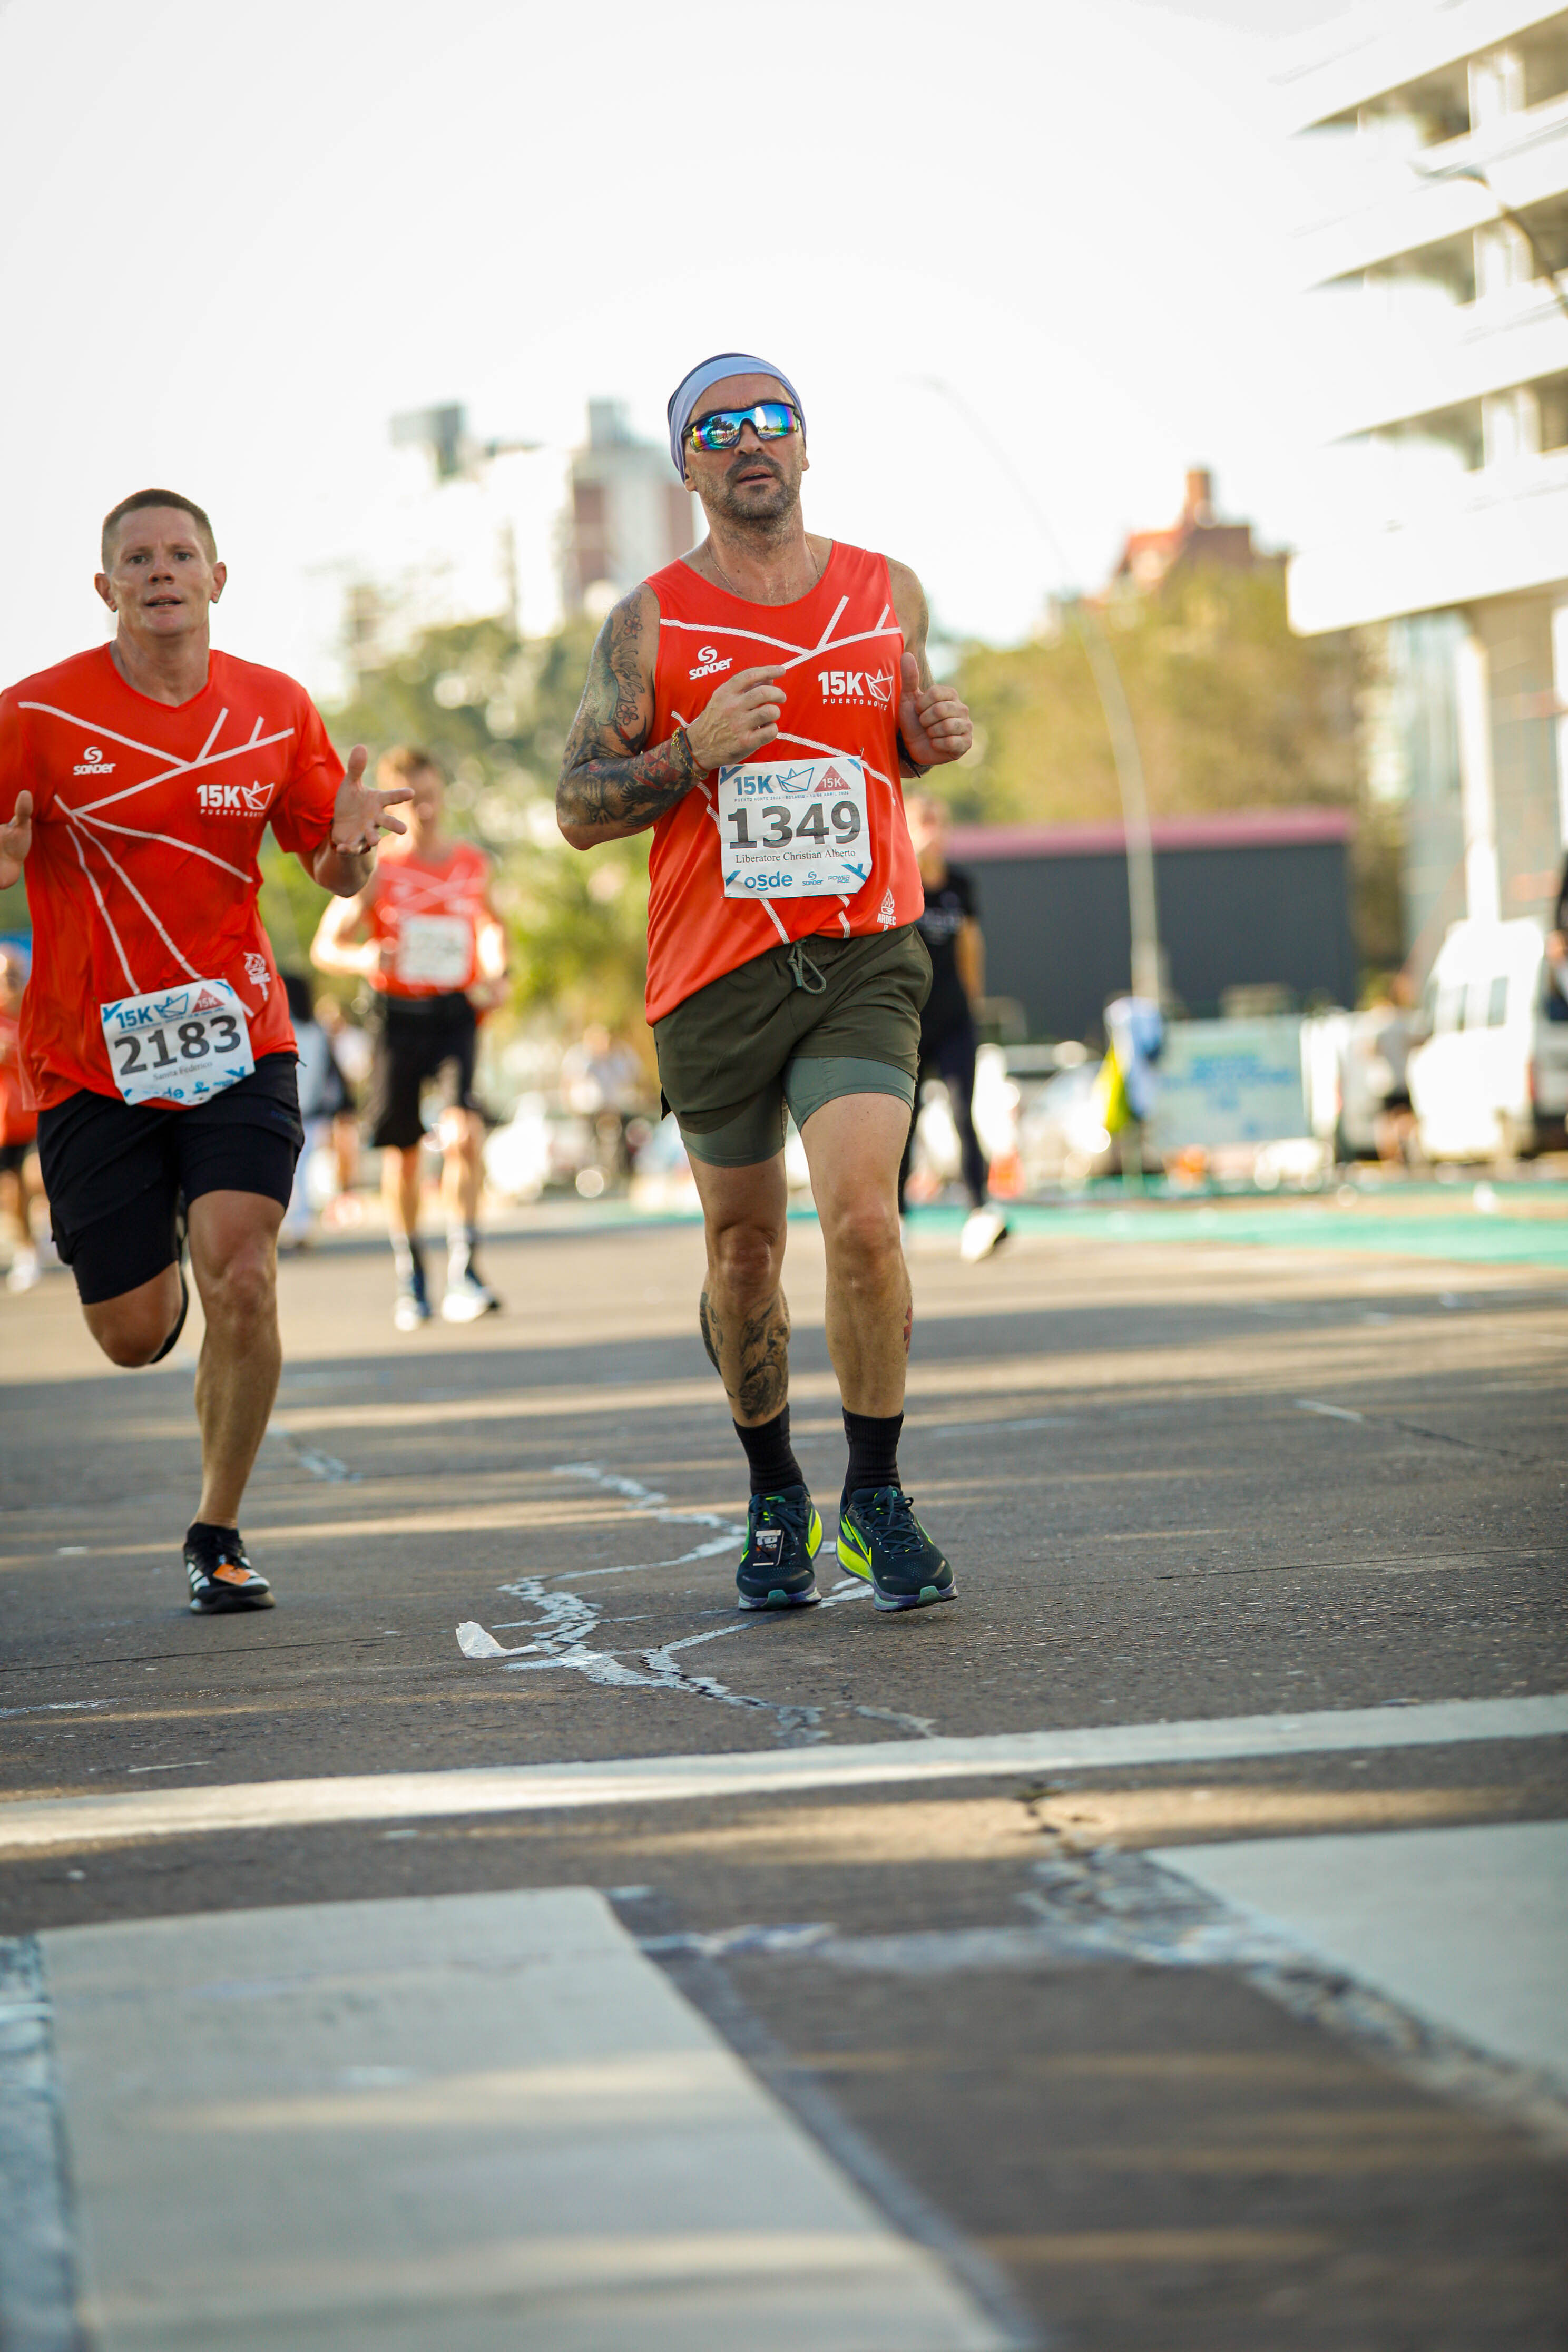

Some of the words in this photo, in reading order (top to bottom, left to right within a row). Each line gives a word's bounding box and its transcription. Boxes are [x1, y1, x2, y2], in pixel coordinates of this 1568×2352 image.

[818, 671, 864, 696] 15K
[867, 700, 888, 711] NOTE
[196, 784, 241, 808] 15K
[733, 775, 774, 796] 15K
[822, 777, 842, 788] 15K
[728, 800, 861, 849] 1349
[736, 854, 780, 864] Liberatore
[783, 850, 822, 860] Christian
[825, 849, 856, 858] Alberto
[744, 871, 793, 891] osde
[877, 913, 896, 926] ARDEC
[115, 1006, 153, 1029] 15K
[197, 996, 218, 1009] 15K
[114, 1015, 241, 1076] 2183
